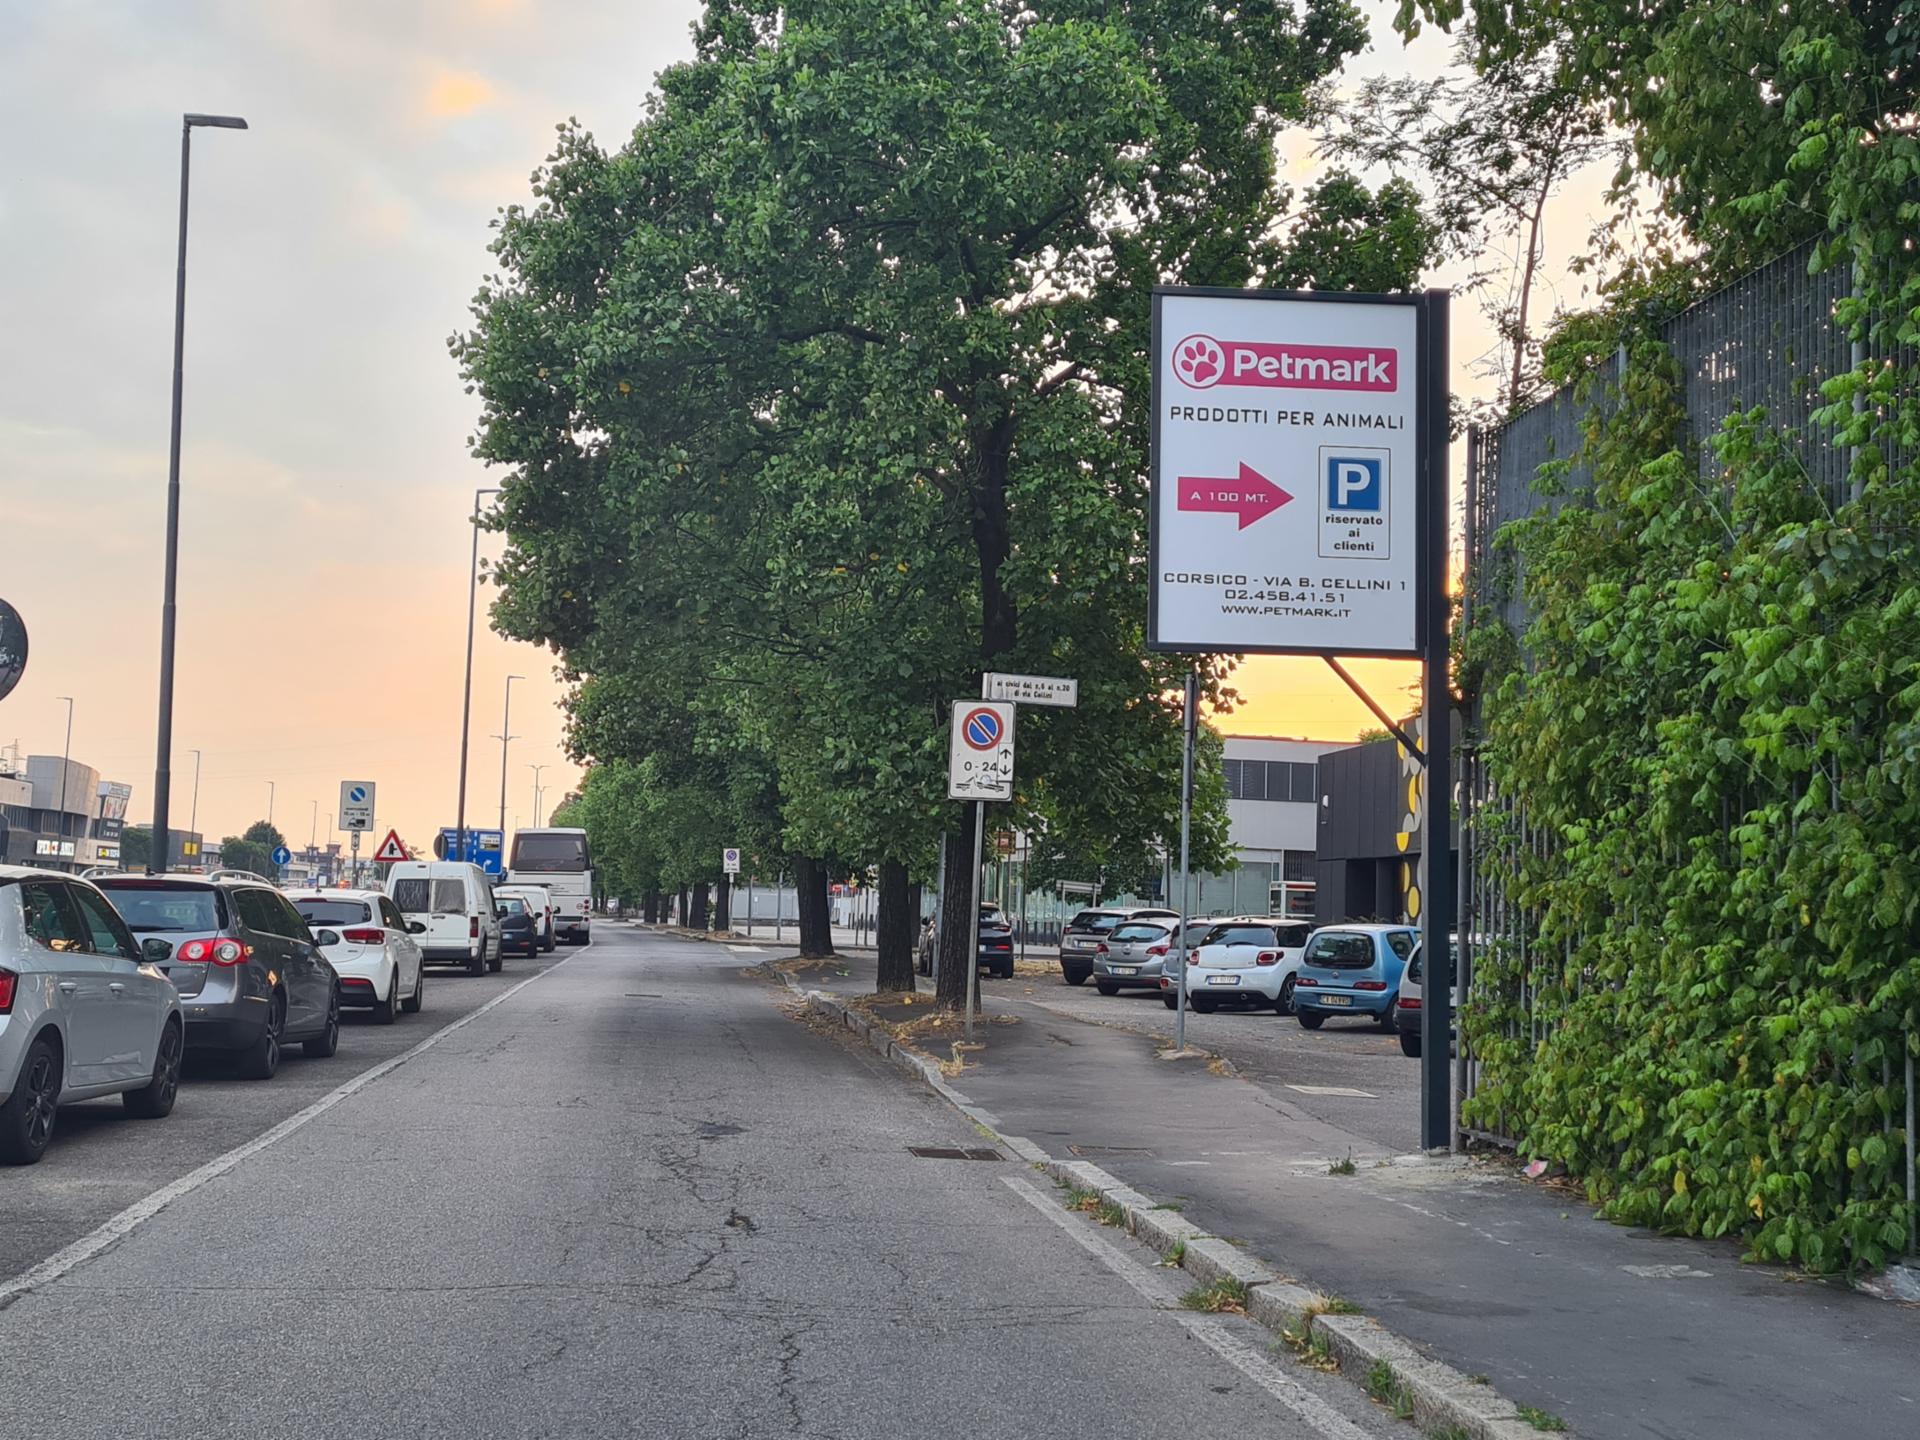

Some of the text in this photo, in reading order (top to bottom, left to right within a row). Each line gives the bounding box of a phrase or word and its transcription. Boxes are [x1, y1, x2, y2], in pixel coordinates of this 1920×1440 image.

[1234, 349, 1391, 383] Petmark
[1171, 407, 1404, 429] PRODOTTI PER ANIMALI
[1338, 463, 1371, 505] P
[1191, 491, 1268, 503] A 100 MT.
[1326, 515, 1383, 525] riservato
[1349, 529, 1360, 537] ai
[1334, 541, 1374, 551] clienti
[1164, 573, 1246, 585] CORSICO
[1264, 576, 1292, 587] VIA
[1300, 578, 1314, 588] B.
[1322, 578, 1390, 590] CELLINI
[1400, 581, 1406, 591] 1
[1225, 590, 1345, 603] 02.458.41.51
[1222, 605, 1351, 618] WWW.PETMARK.IT
[964, 762, 972, 771] 0
[983, 762, 997, 771] 24
